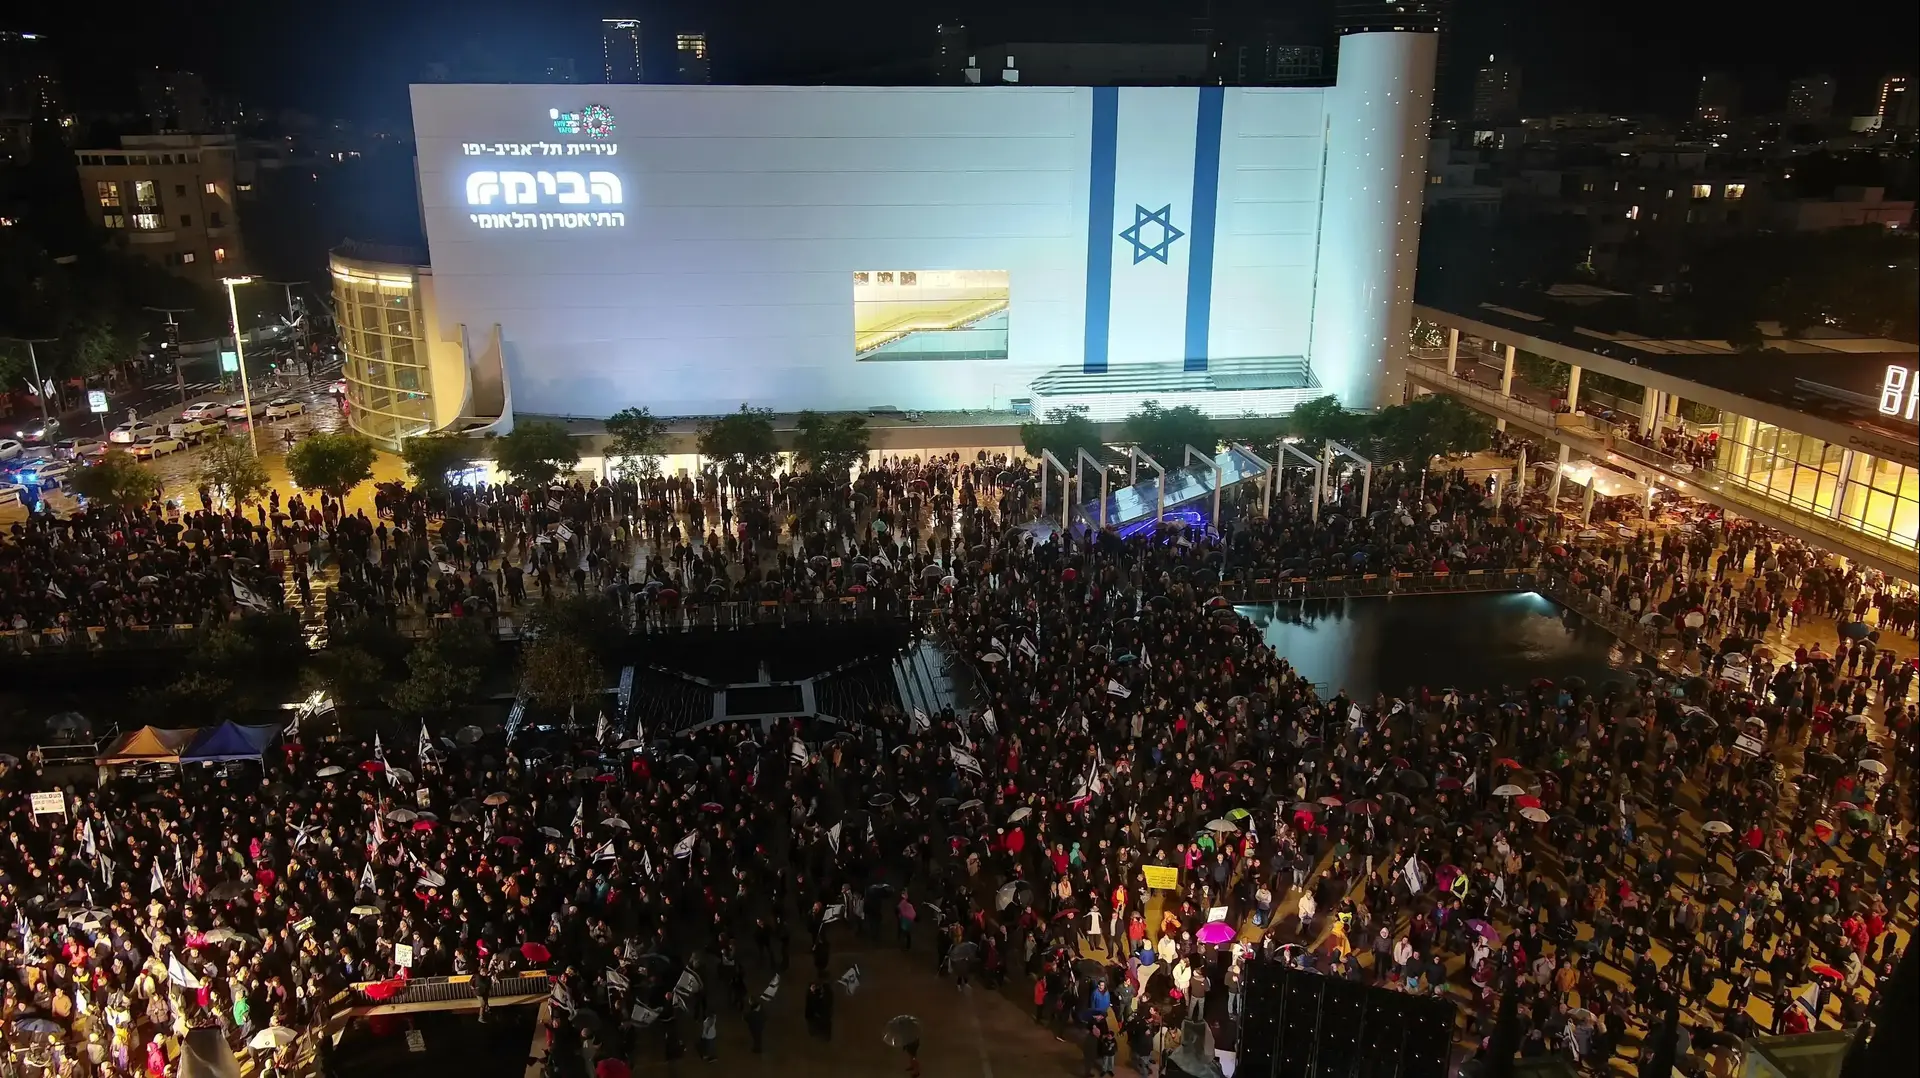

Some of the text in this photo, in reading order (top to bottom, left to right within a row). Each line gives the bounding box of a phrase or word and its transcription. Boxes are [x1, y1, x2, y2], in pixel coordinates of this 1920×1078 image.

[567, 143, 618, 156] עיריית
[470, 211, 625, 230] התיאטרון הלאומי
